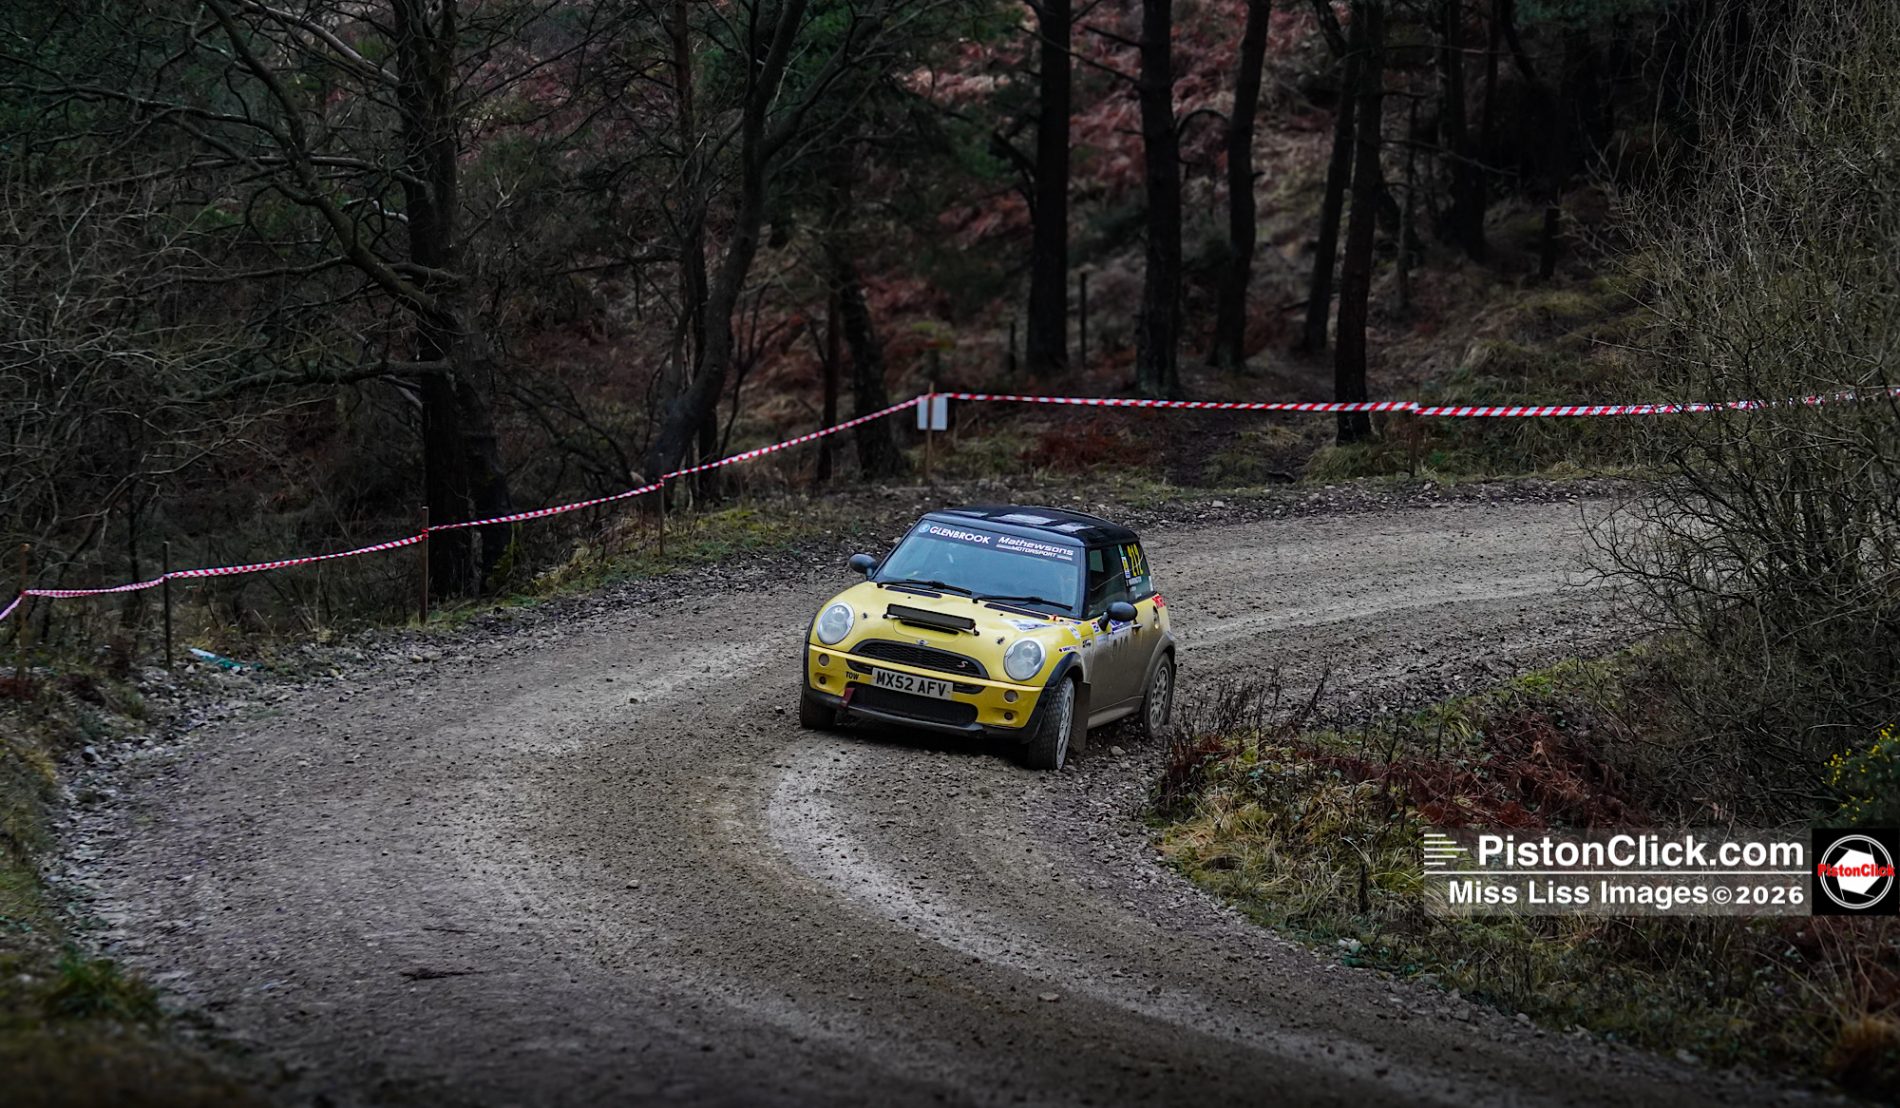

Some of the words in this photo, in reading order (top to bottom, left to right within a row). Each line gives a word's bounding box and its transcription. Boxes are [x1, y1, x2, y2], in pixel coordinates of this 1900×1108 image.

[929, 526, 991, 544] GLENBROOK
[998, 536, 1074, 556] Mathewsons
[1011, 546, 1057, 558] MOTORSPORT
[845, 671, 860, 681] TOW
[876, 670, 914, 691] MX52
[917, 679, 947, 697] AFV
